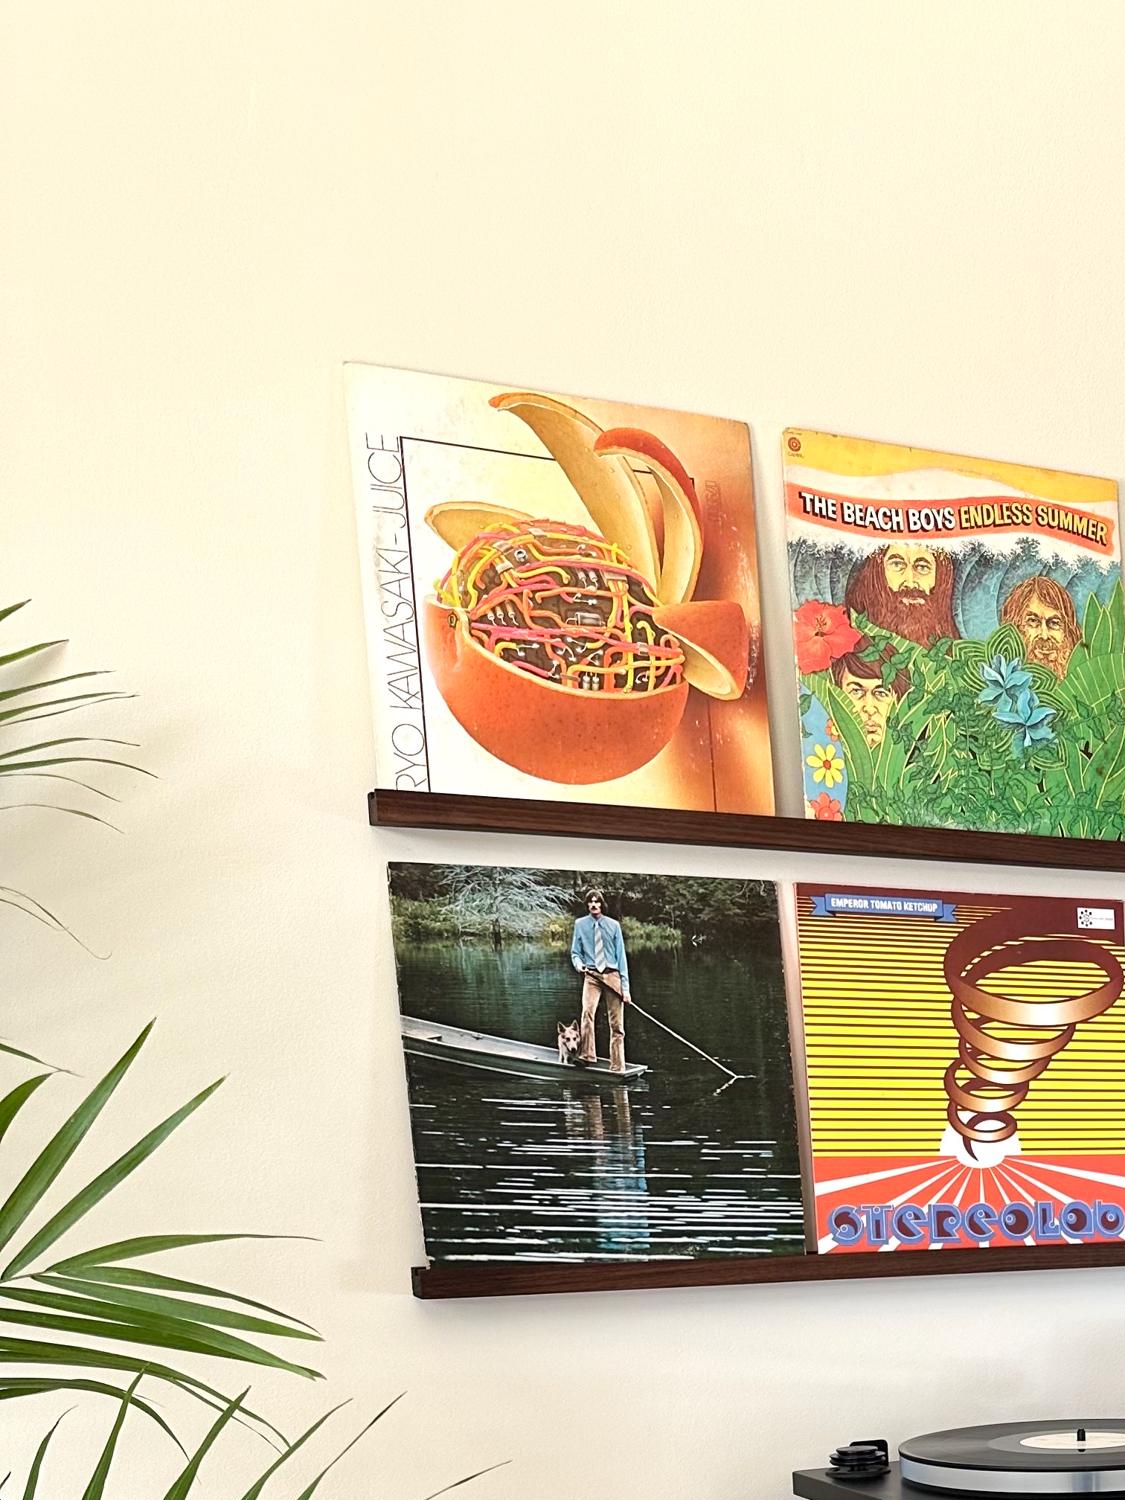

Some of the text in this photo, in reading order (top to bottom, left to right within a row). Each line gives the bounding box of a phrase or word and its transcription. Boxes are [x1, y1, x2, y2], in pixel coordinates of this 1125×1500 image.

[799, 490, 1108, 546] THE BEACH BOYS ENDLESS SUMMER
[392, 723, 427, 791] RYO
[830, 898, 938, 913] EMPEROR TOMATO KETCHUP
